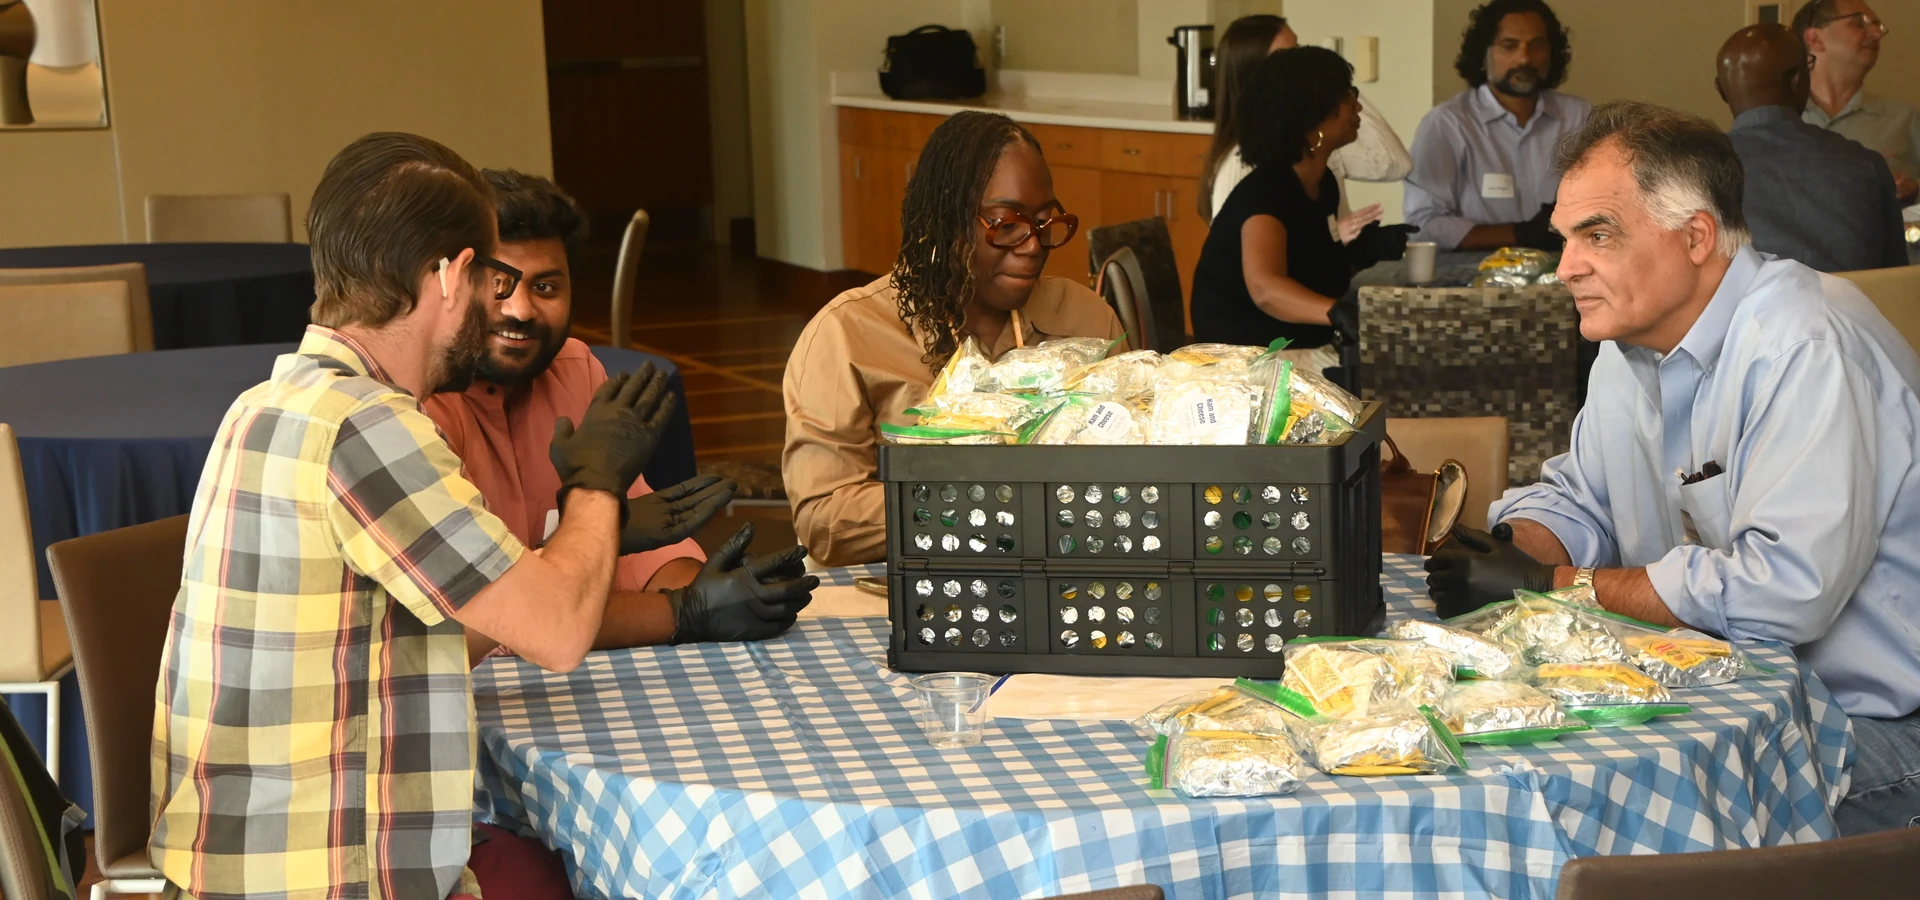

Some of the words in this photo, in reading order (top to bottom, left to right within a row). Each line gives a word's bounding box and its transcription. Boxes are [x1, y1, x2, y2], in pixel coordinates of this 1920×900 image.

[1088, 413, 1099, 425] Ham
[1096, 404, 1105, 415] and
[1097, 410, 1113, 428] Cheese
[1196, 402, 1206, 425] Cheese
